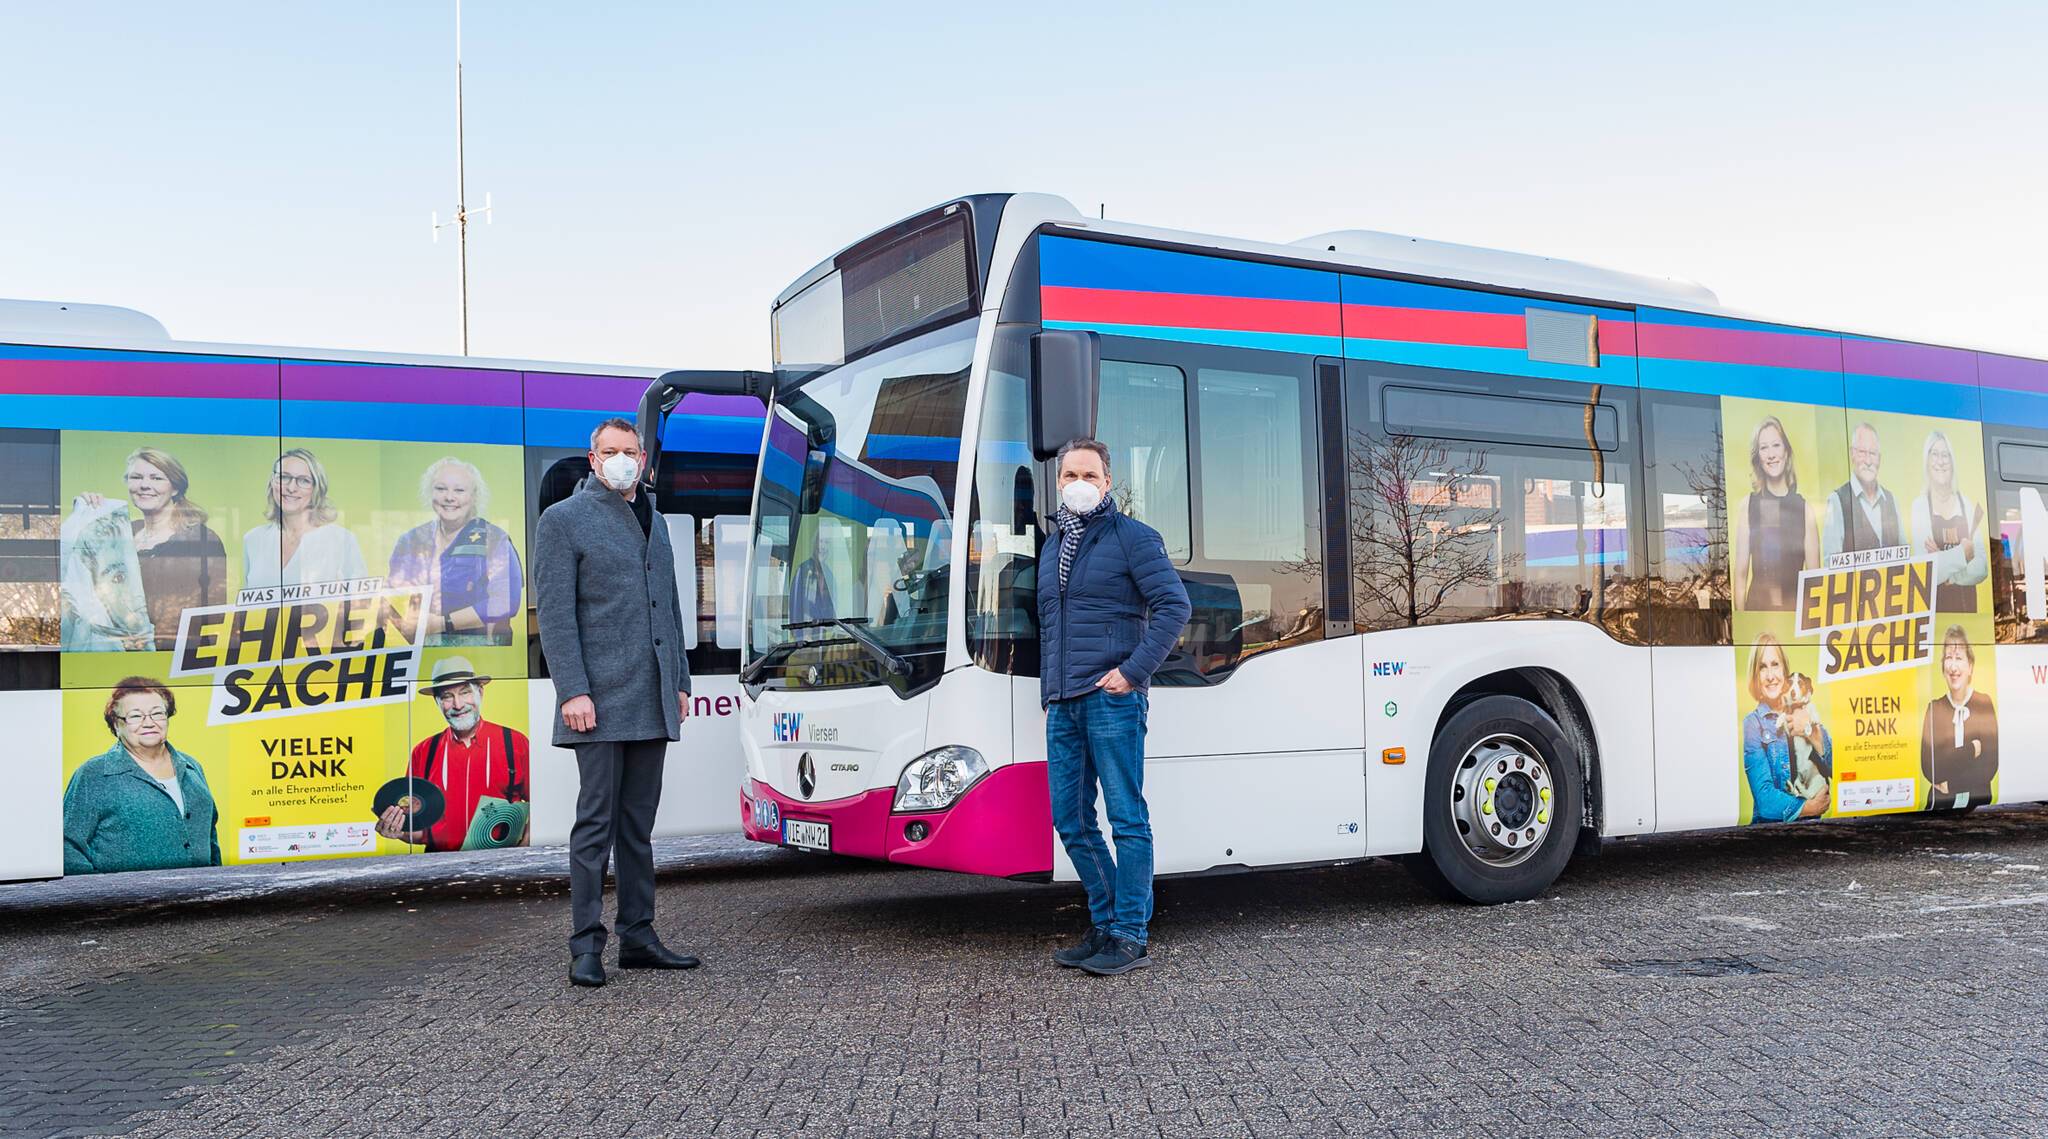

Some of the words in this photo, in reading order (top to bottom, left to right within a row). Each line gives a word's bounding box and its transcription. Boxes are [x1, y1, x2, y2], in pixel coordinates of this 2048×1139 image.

[1831, 554, 1850, 566] WAS
[1853, 552, 1871, 563] WIR
[1875, 549, 1893, 561] TUN
[1896, 547, 1909, 558] IST
[241, 589, 274, 604] WAS
[283, 584, 312, 599] WIR
[319, 581, 350, 596] TUN
[357, 579, 381, 592] IST
[1801, 561, 1933, 631] EHREN
[181, 592, 423, 671] EHREN
[1825, 616, 1930, 675] SACHE
[220, 651, 413, 717] SACHE
[1849, 696, 1901, 715] VIELEN
[808, 723, 839, 742] Viersen
[1855, 717, 1898, 737] DANK
[261, 736, 353, 757] VIELEN
[1853, 742, 1863, 751] alle
[1855, 754, 1876, 762] unseres
[1877, 752, 1899, 762] Kreises!
[271, 758, 347, 780] DANK
[830, 763, 860, 772] CITARO
[251, 788, 264, 796] an
[266, 785, 284, 796] alle
[286, 782, 365, 795] Ehrenamtlichen
[268, 798, 307, 807] unseres
[309, 794, 348, 805] Kreises!
[817, 826, 828, 847] 21
